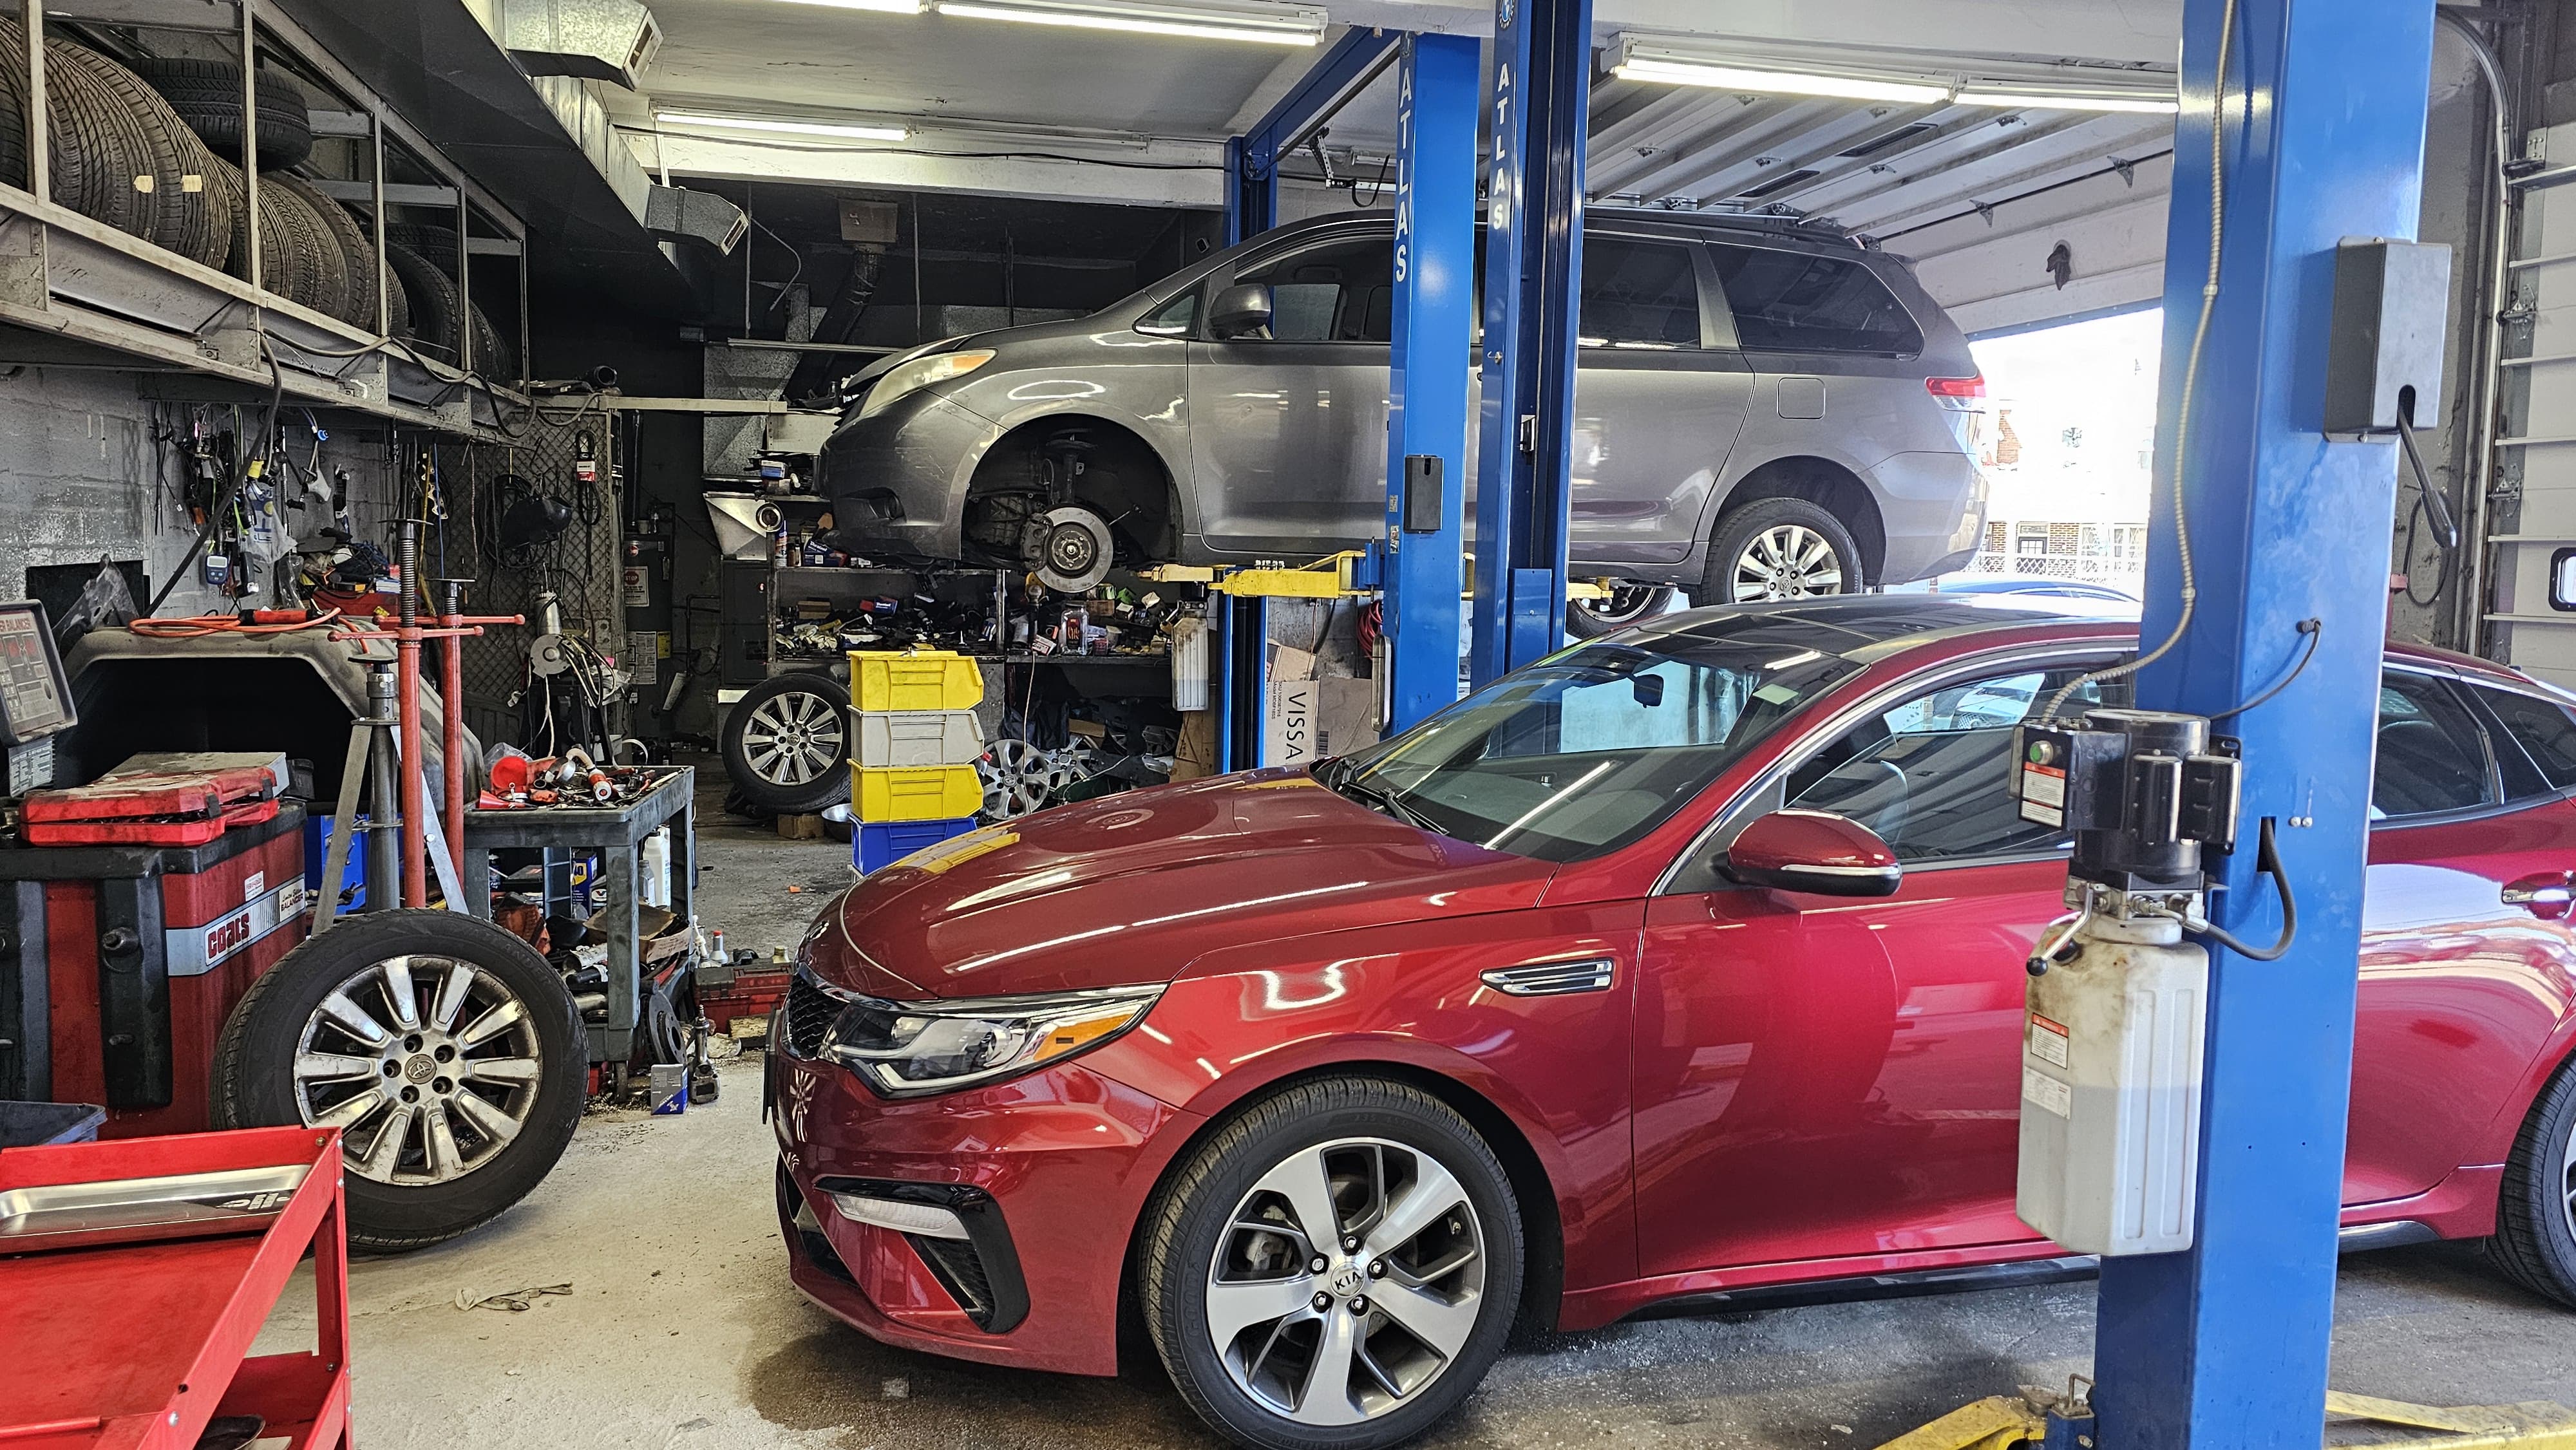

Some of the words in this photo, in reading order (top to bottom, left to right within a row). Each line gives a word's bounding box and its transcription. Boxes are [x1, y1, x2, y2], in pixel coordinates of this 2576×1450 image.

[1396, 66, 1413, 283] ATLAS
[1493, 62, 1511, 231] ATLAS
[1285, 692, 1307, 760] VISSA
[281, 894, 303, 911] BALANCER
[1334, 1271, 1361, 1290] KIA
